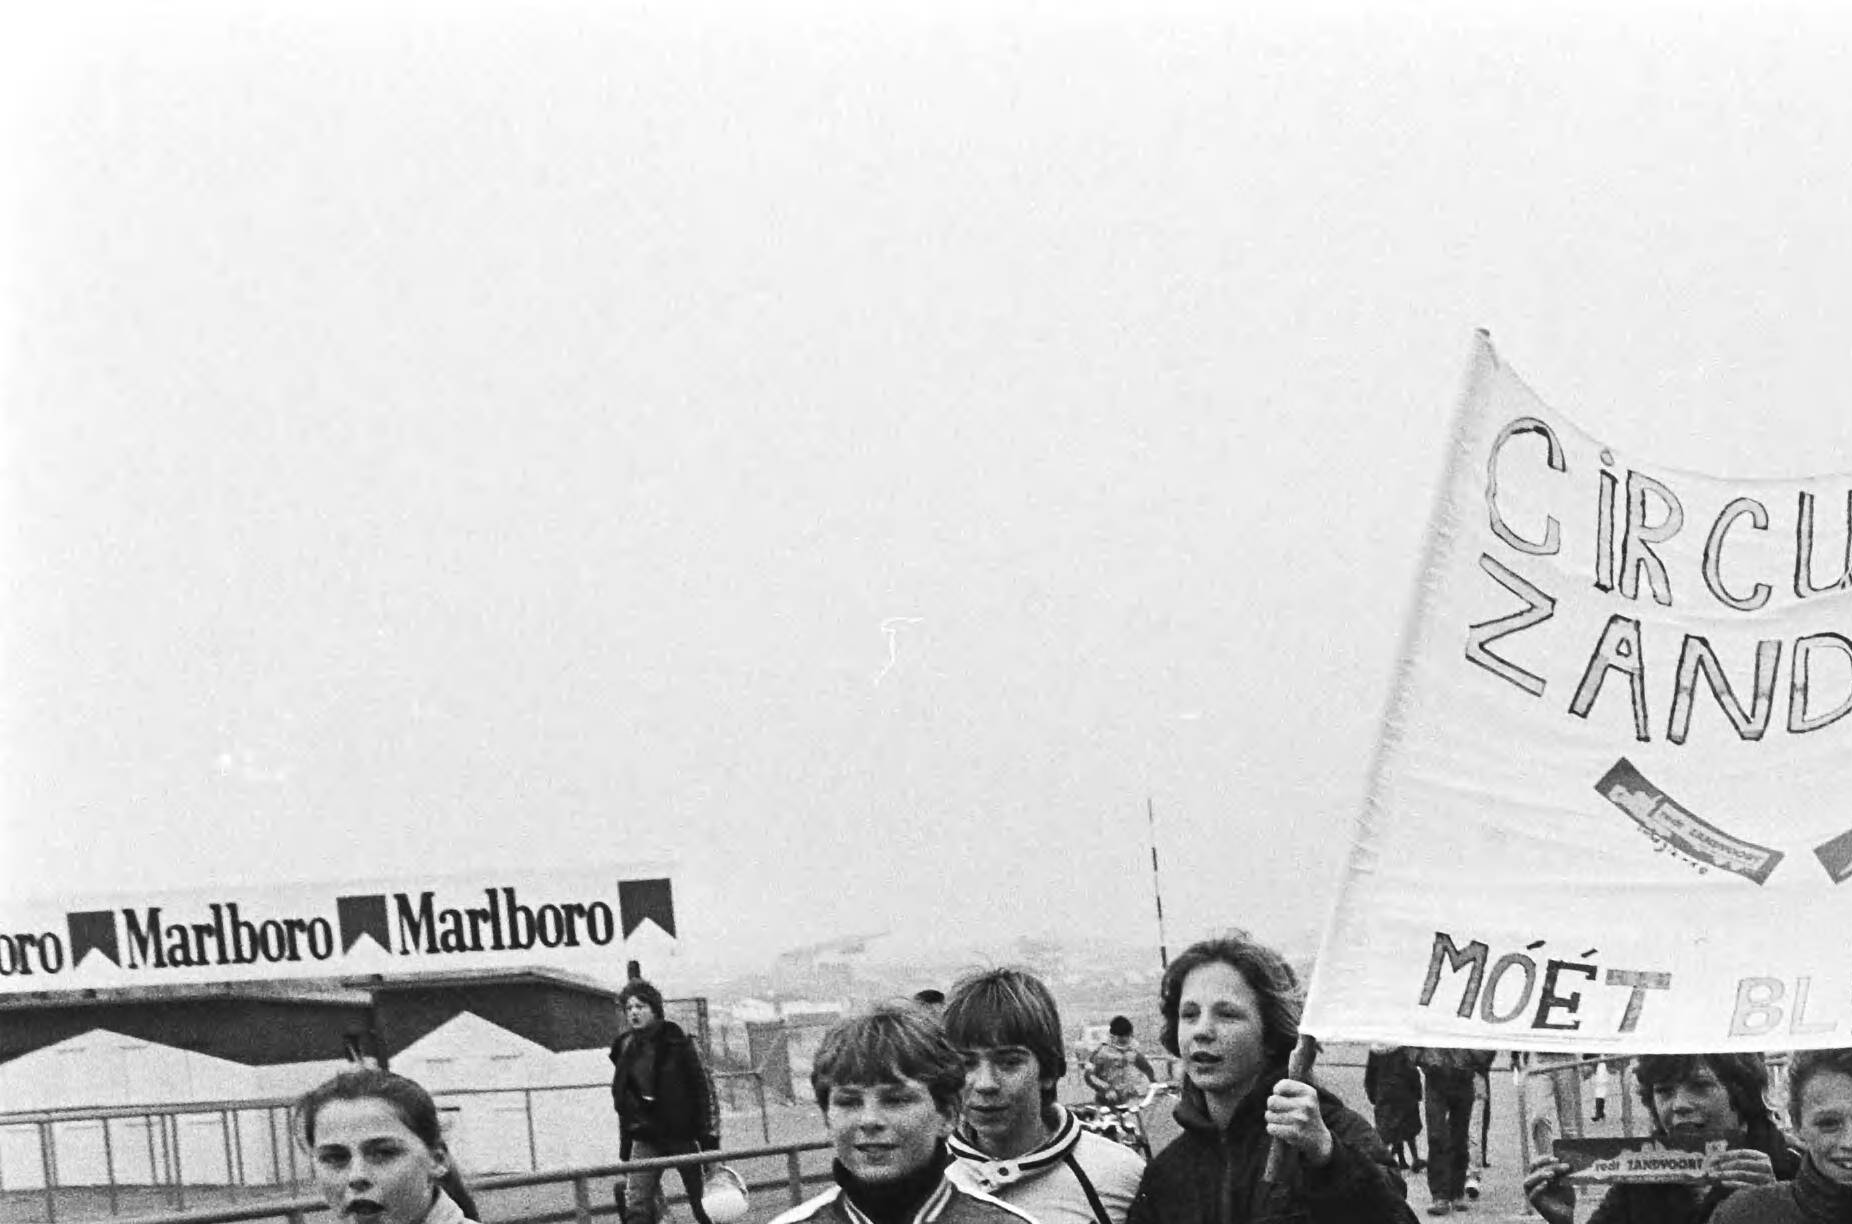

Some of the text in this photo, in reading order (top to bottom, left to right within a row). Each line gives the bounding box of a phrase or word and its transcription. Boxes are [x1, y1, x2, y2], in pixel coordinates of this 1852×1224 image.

[121, 903, 335, 970] Marlboro
[392, 886, 616, 955] Marlboro
[1627, 1156, 1704, 1172] ZANDVOORT
